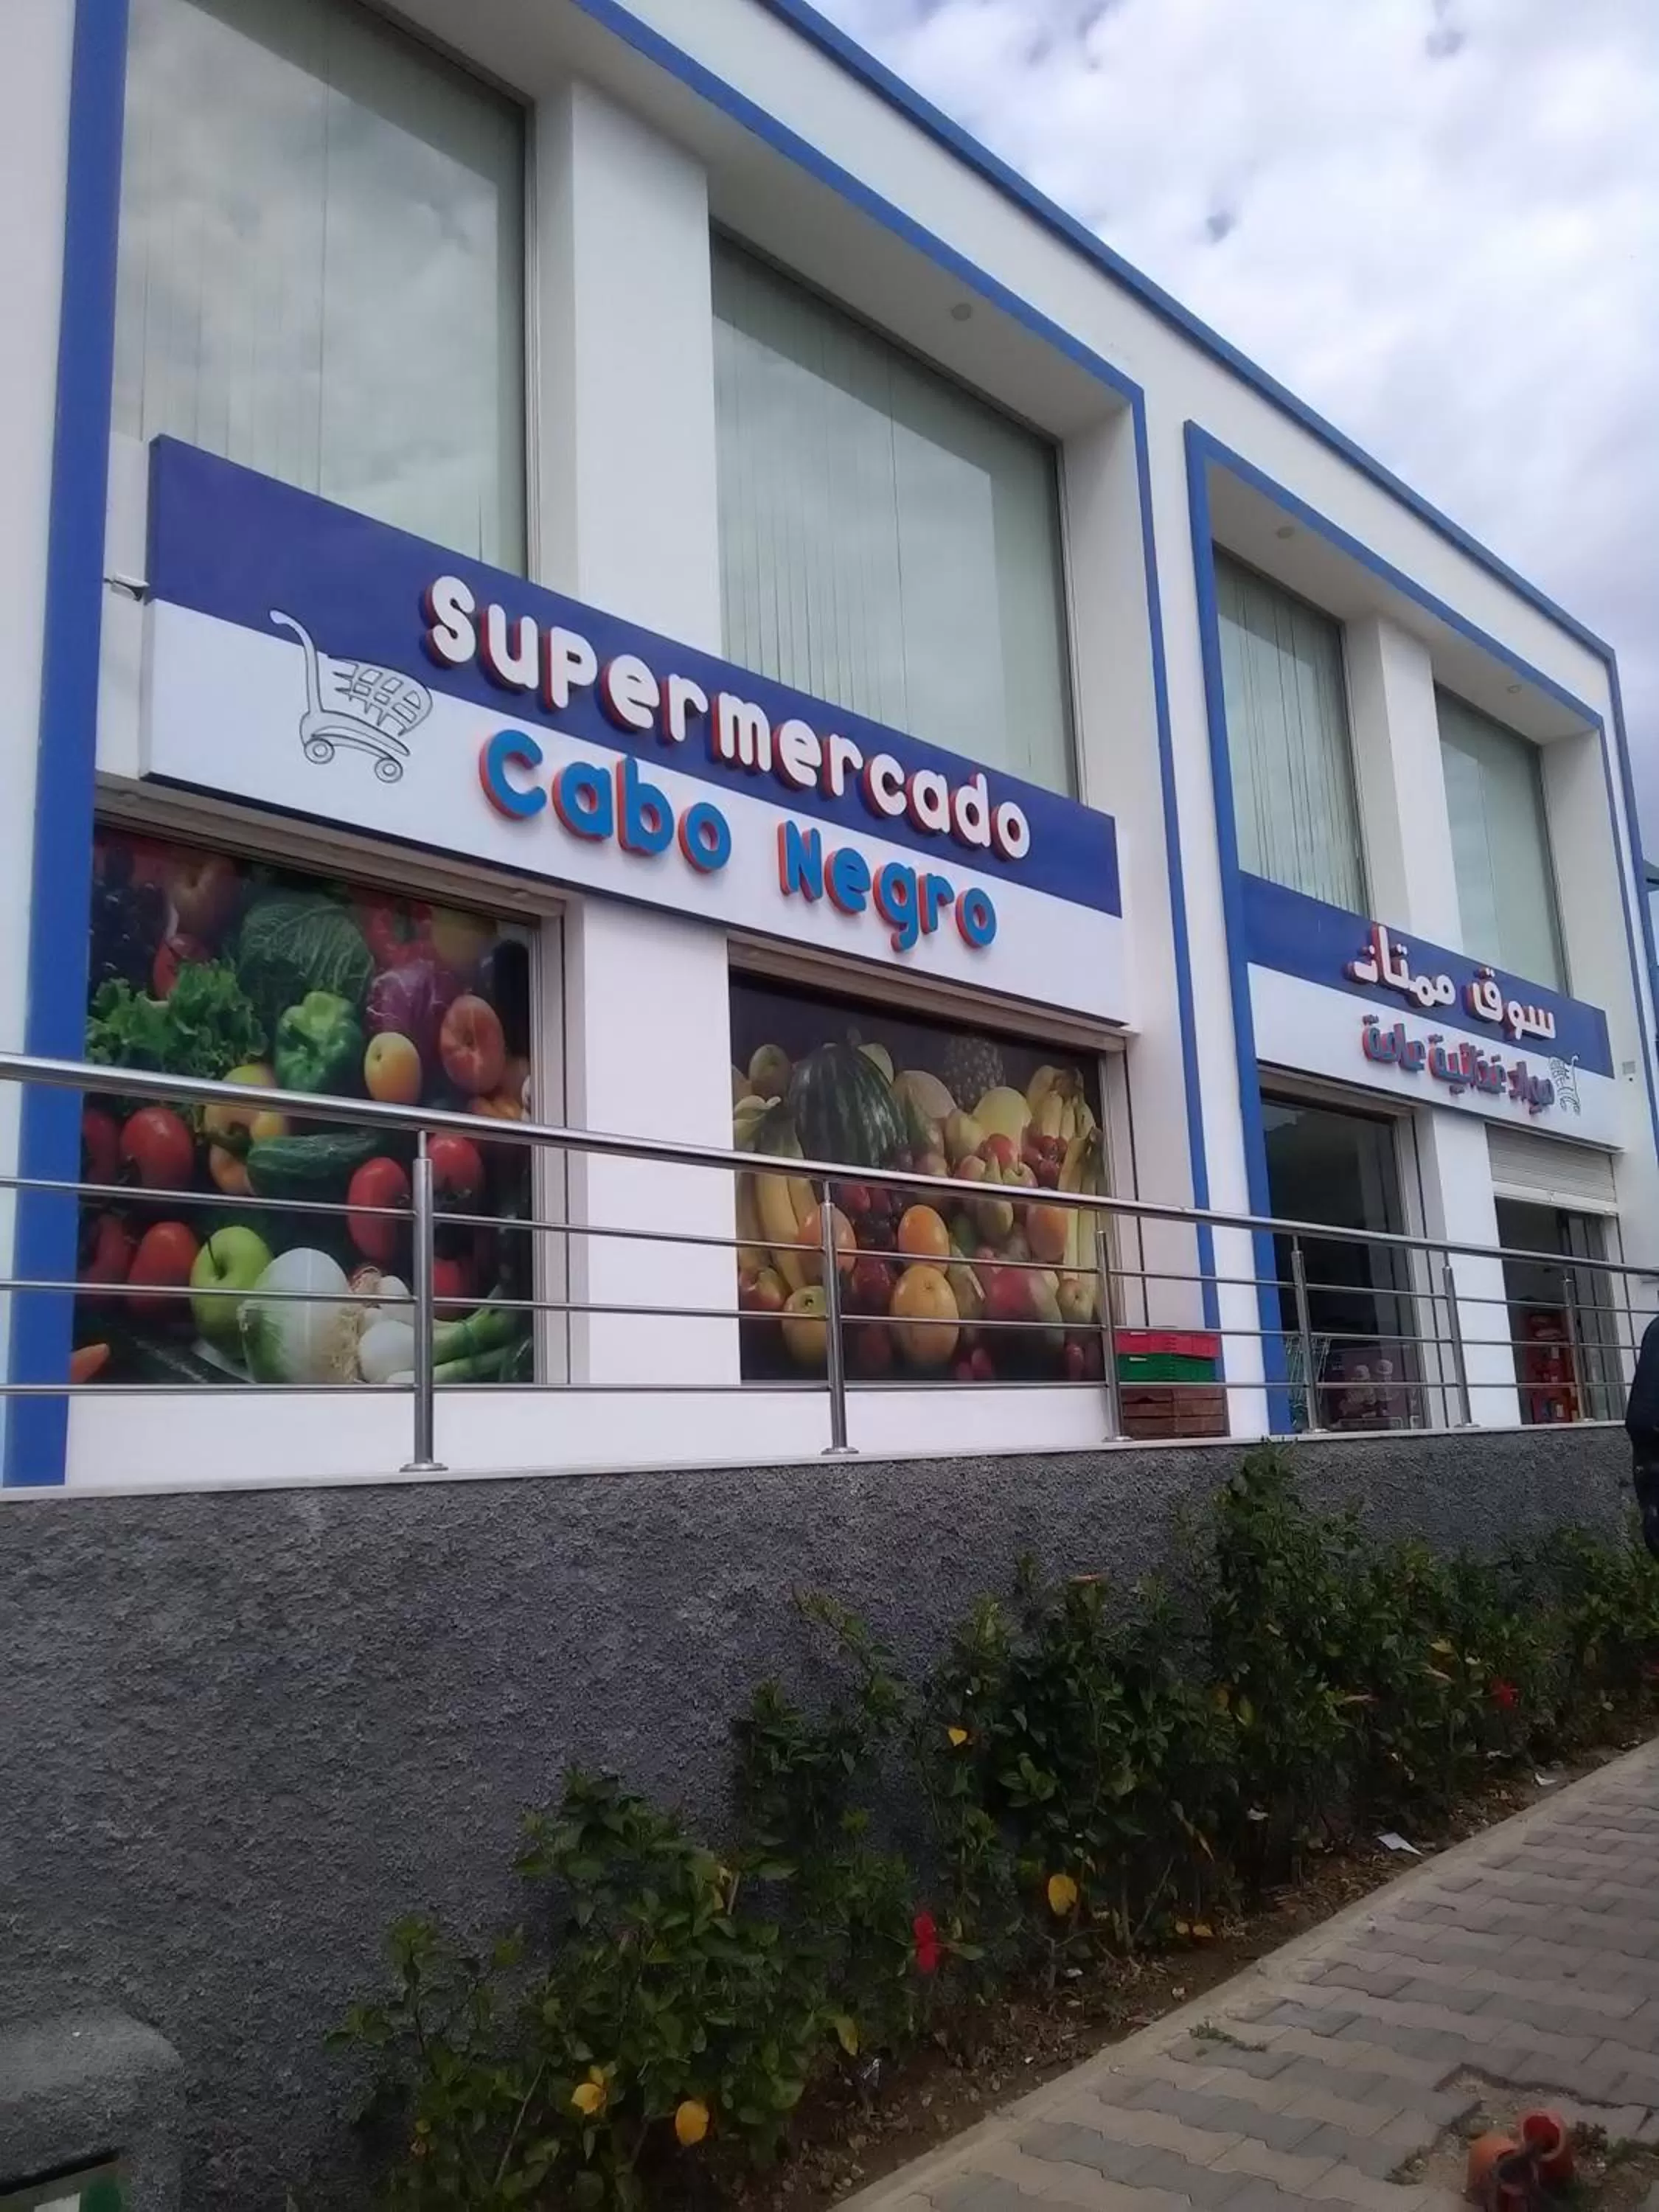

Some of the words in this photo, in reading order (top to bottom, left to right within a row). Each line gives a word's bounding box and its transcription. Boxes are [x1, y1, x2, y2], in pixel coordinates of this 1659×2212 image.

[423, 574, 1032, 862] Supermercado
[479, 728, 732, 873] Cabo
[778, 819, 998, 953] Negro
[1345, 922, 1456, 1007] ممتاز
[1465, 967, 1557, 1040] سوق
[1362, 1013, 1427, 1073] عامة
